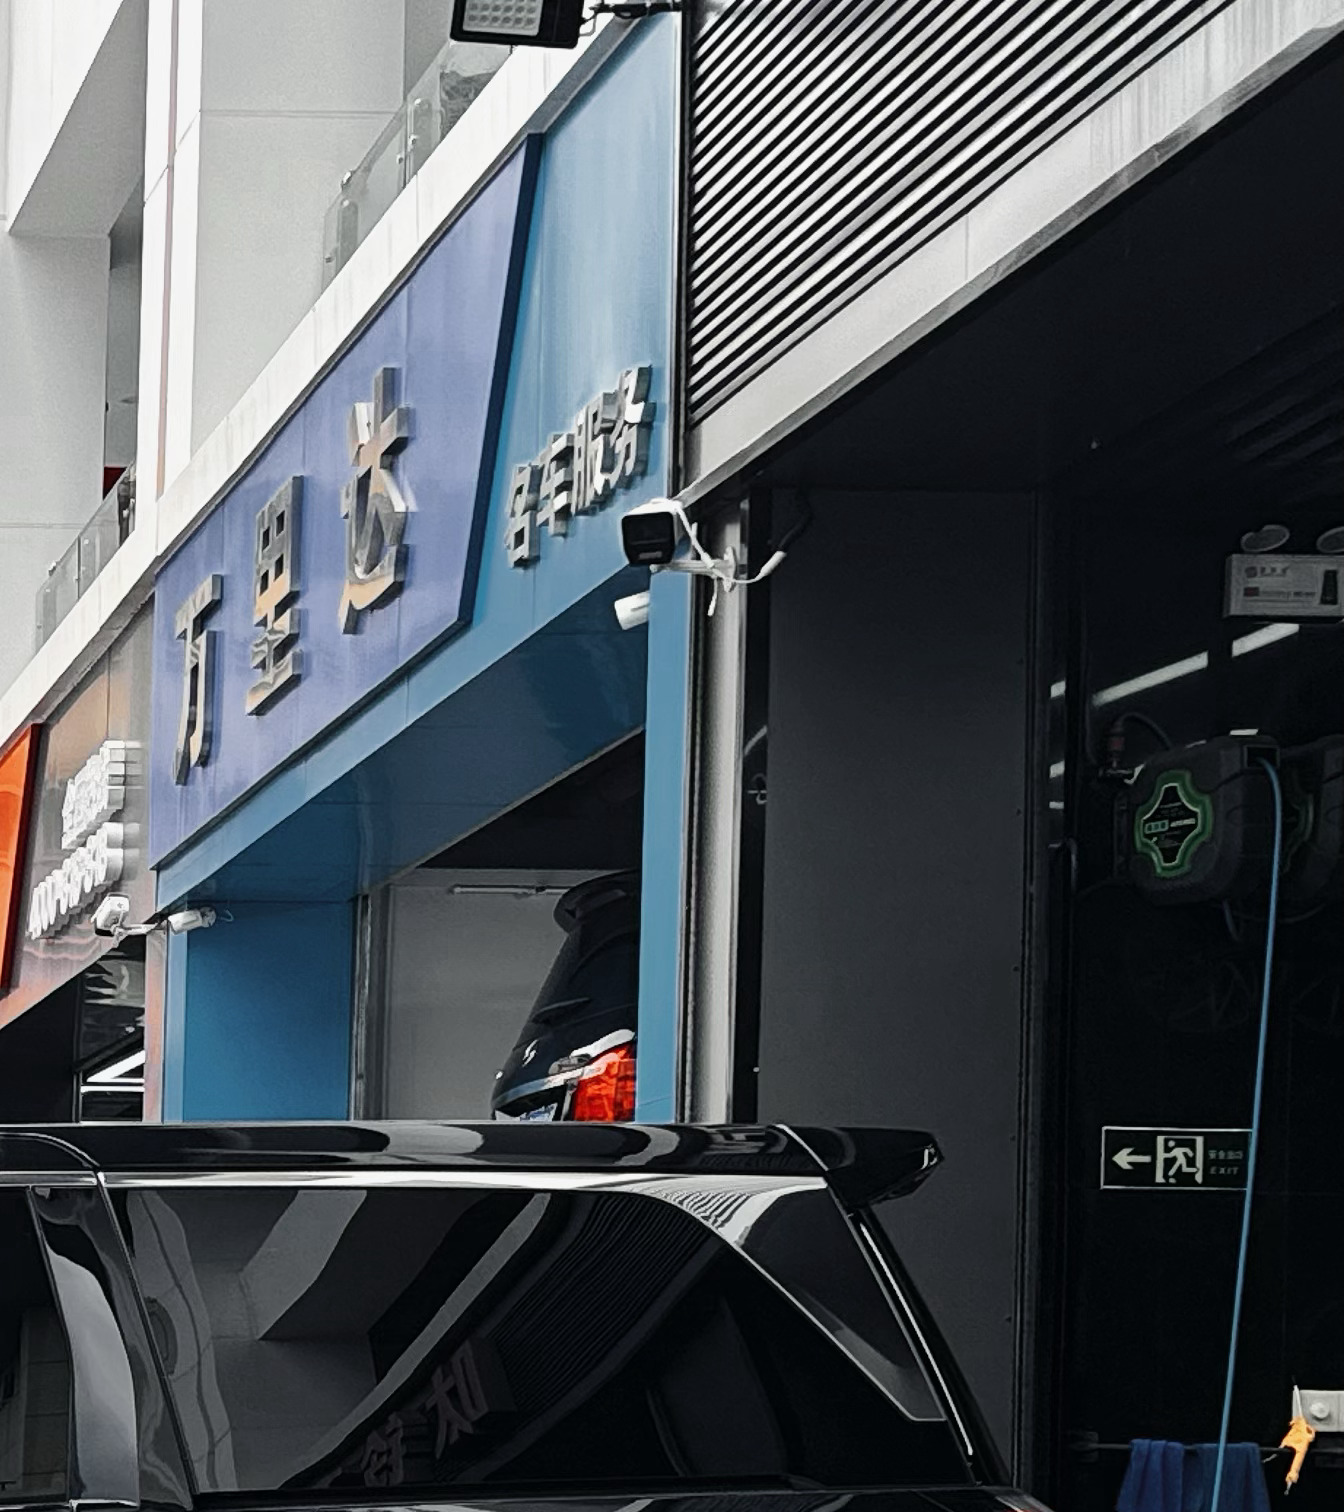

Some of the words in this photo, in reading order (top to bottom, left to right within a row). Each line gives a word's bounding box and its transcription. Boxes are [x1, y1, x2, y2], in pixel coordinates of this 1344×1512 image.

[173, 367, 417, 785] 万里达
[505, 364, 654, 569] 名车服务
